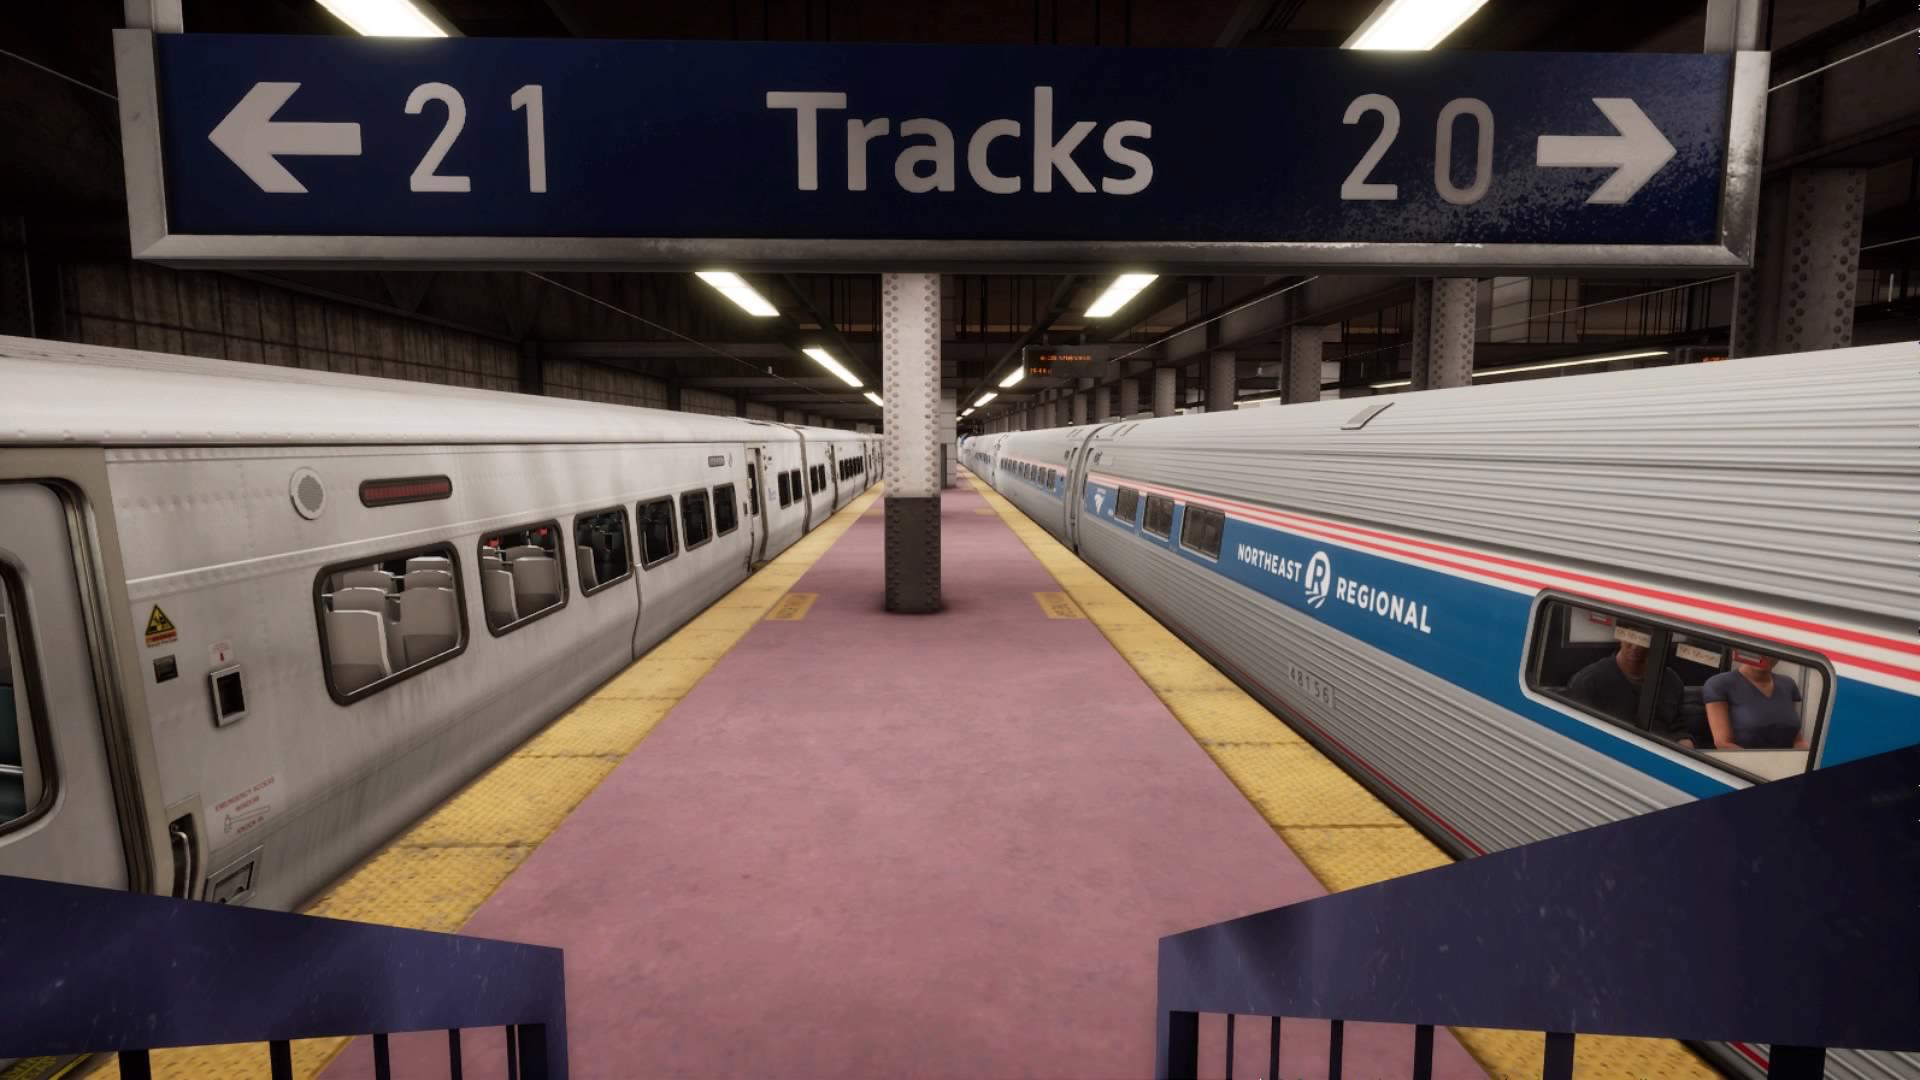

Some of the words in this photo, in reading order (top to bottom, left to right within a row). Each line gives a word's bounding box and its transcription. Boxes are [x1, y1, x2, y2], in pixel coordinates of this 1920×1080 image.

[403, 81, 548, 194] 21
[766, 86, 1154, 195] Tracks
[1340, 93, 1495, 205] 20
[1237, 543, 1303, 583] NORTHEAST
[1336, 577, 1432, 634] REGIONAL
[1290, 666, 1330, 704] 48156
